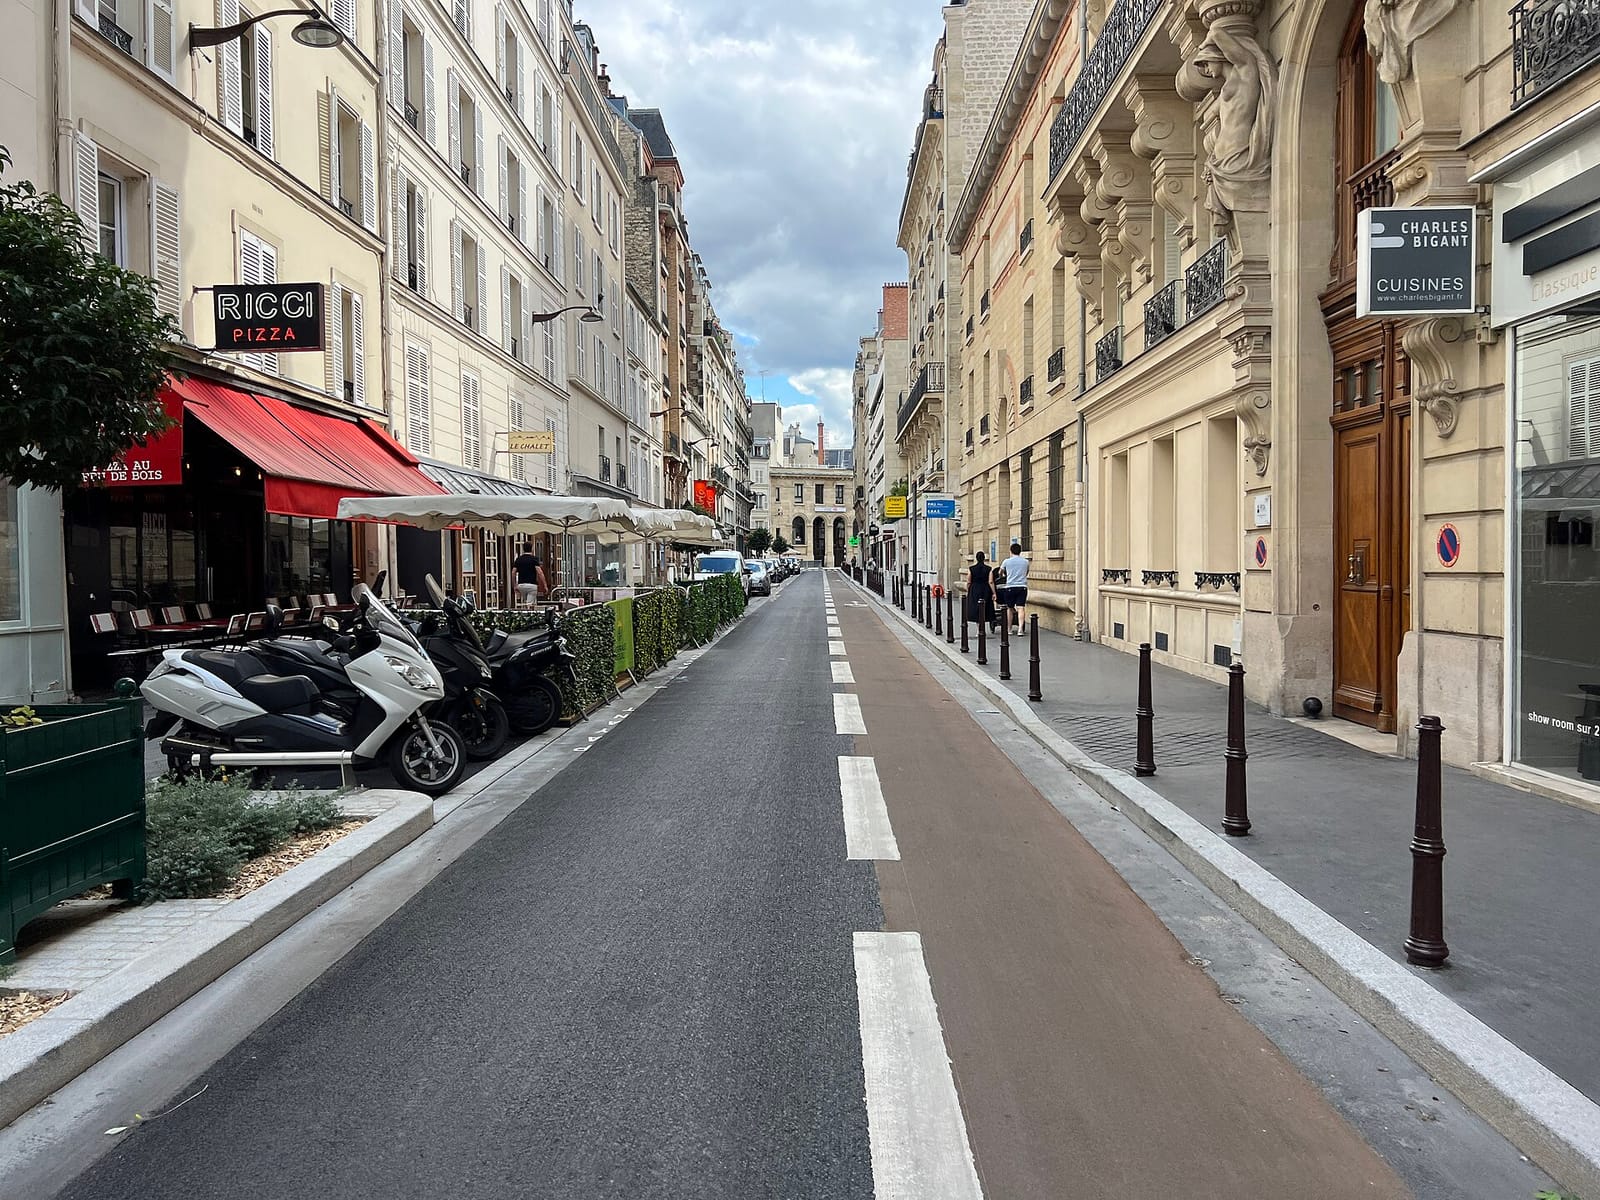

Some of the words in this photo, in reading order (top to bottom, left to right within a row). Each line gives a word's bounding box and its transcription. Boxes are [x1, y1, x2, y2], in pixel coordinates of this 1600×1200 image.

[1401, 221, 1469, 234] CHARLES
[1413, 235, 1469, 248] BIGANT
[1376, 277, 1464, 292] CUISINES
[218, 291, 313, 320] RICCI
[233, 327, 296, 343] PIZZA
[132, 460, 151, 471] AU
[111, 471, 128, 482] DE
[131, 470, 163, 481] BOIS
[1528, 711, 1550, 725] show
[1552, 718, 1575, 731] room
[1577, 723, 1592, 735] sur
